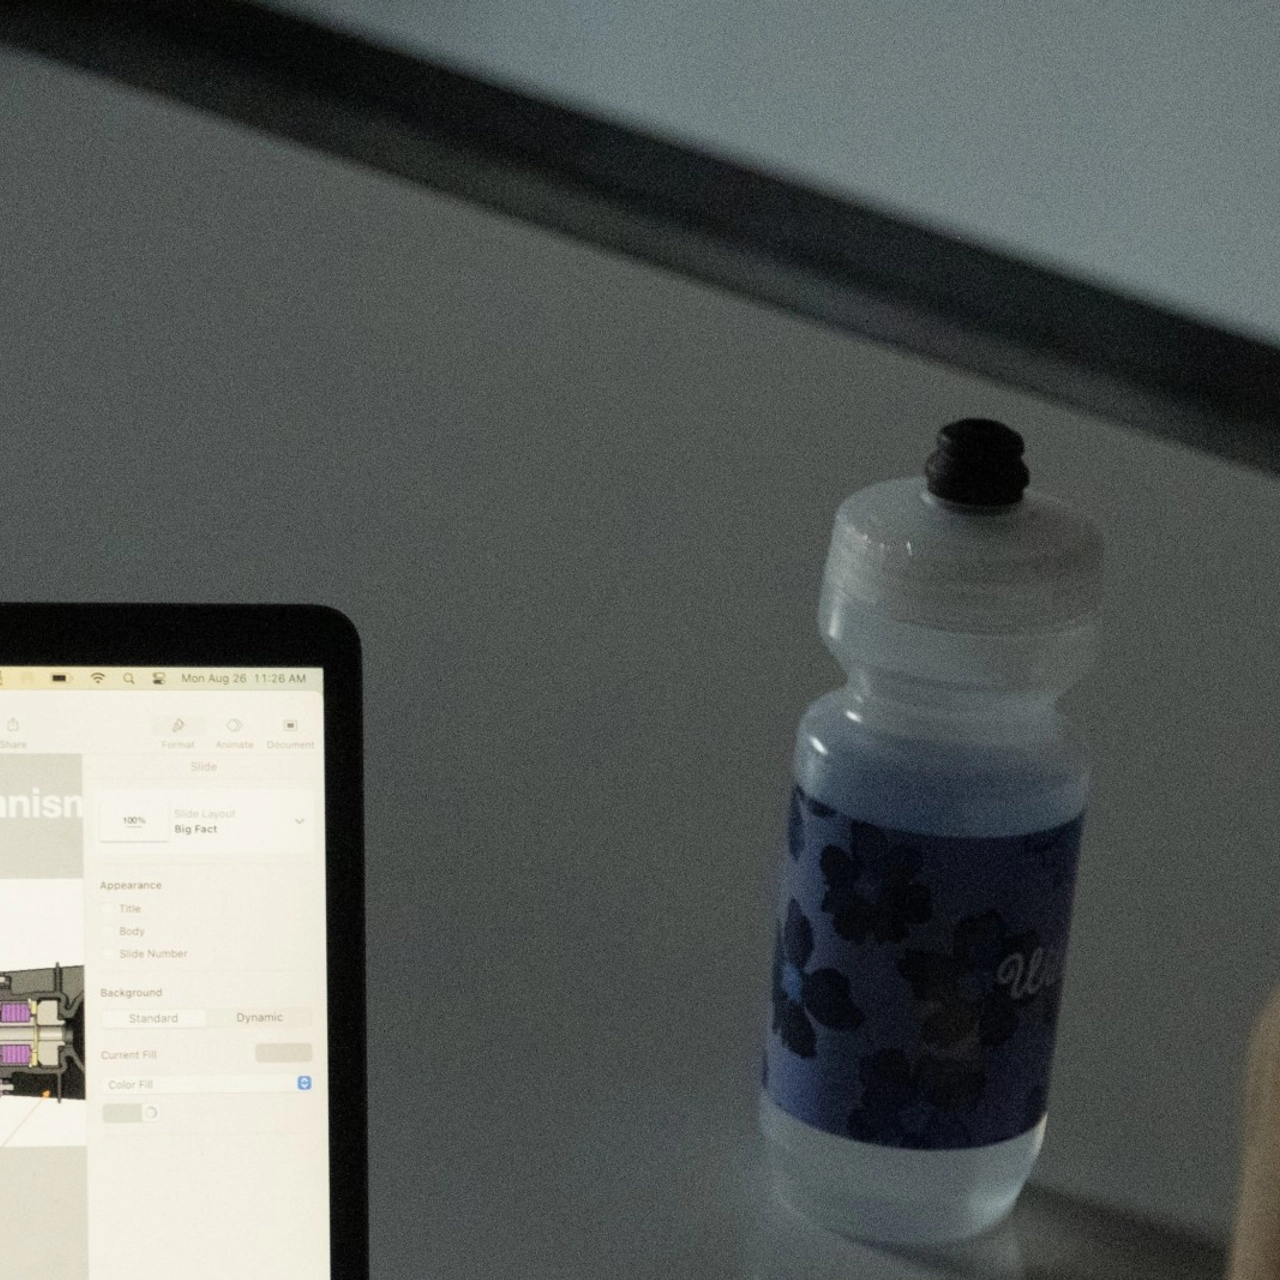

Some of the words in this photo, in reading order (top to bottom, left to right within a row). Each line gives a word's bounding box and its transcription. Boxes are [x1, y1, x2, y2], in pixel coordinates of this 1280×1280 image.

[181, 674, 205, 683] Mon
[208, 674, 229, 685] Aug
[233, 674, 247, 683] 26
[254, 674, 285, 683] 11:26
[288, 674, 306, 683] AM
[0, 740, 27, 750] Share
[162, 740, 194, 750] Format
[216, 740, 254, 750] Animate
[266, 740, 315, 750] Document
[190, 762, 218, 772] Slide
[174, 809, 198, 818] Slide
[202, 809, 236, 820] Layout
[174, 824, 192, 836] Big
[195, 824, 218, 834] Fact
[100, 880, 162, 891] Appearance
[120, 904, 141, 913] Title
[120, 926, 145, 938] Body
[120, 949, 144, 958] Slide
[148, 949, 188, 958] Number
[100, 988, 162, 998] Background
[129, 1013, 178, 1024] Standard
[236, 1012, 283, 1024] Dynamic
[101, 1050, 139, 1060] Current
[142, 1050, 157, 1060] Fill
[108, 1080, 136, 1090] Color
[139, 1080, 153, 1090] Fill
